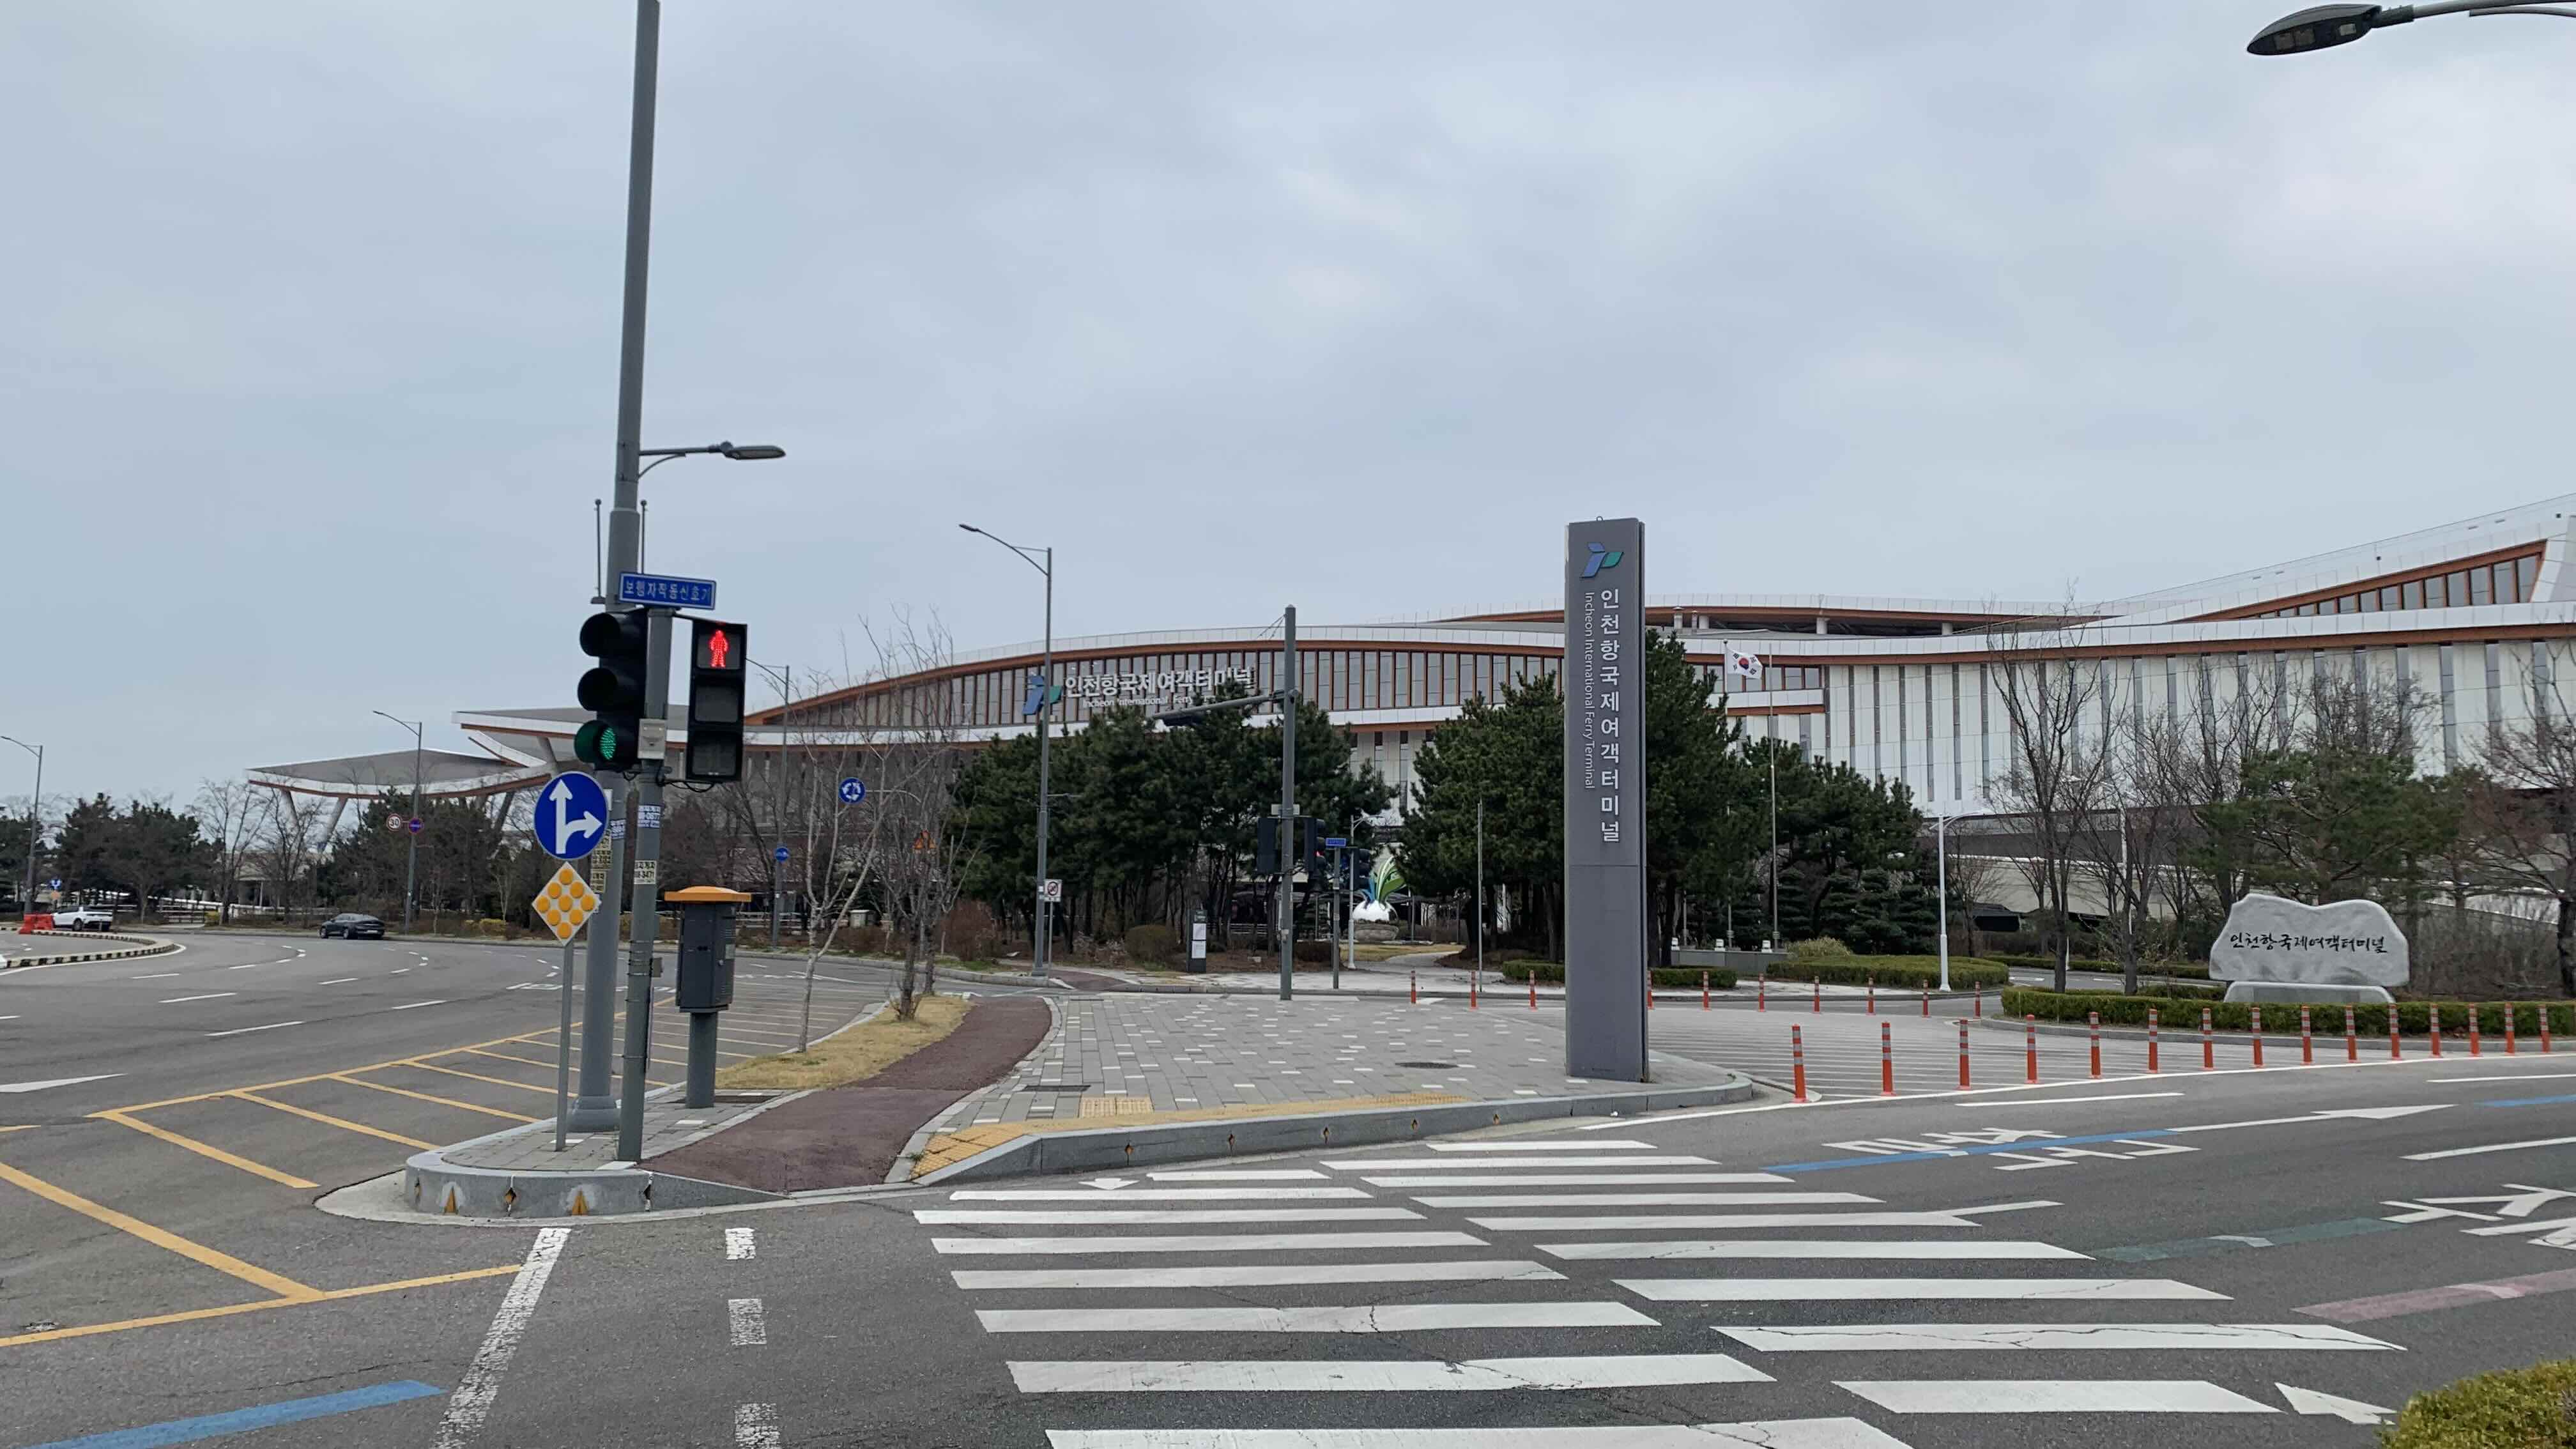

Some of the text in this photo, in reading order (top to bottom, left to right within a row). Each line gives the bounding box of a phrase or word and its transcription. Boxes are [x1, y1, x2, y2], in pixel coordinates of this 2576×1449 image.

[1583, 592, 1595, 789] Incheon International Ferry Terminal
[1599, 588, 1620, 842] 인천항국제여객터미널
[2230, 932, 2388, 954] 인천항국제여객터미널
